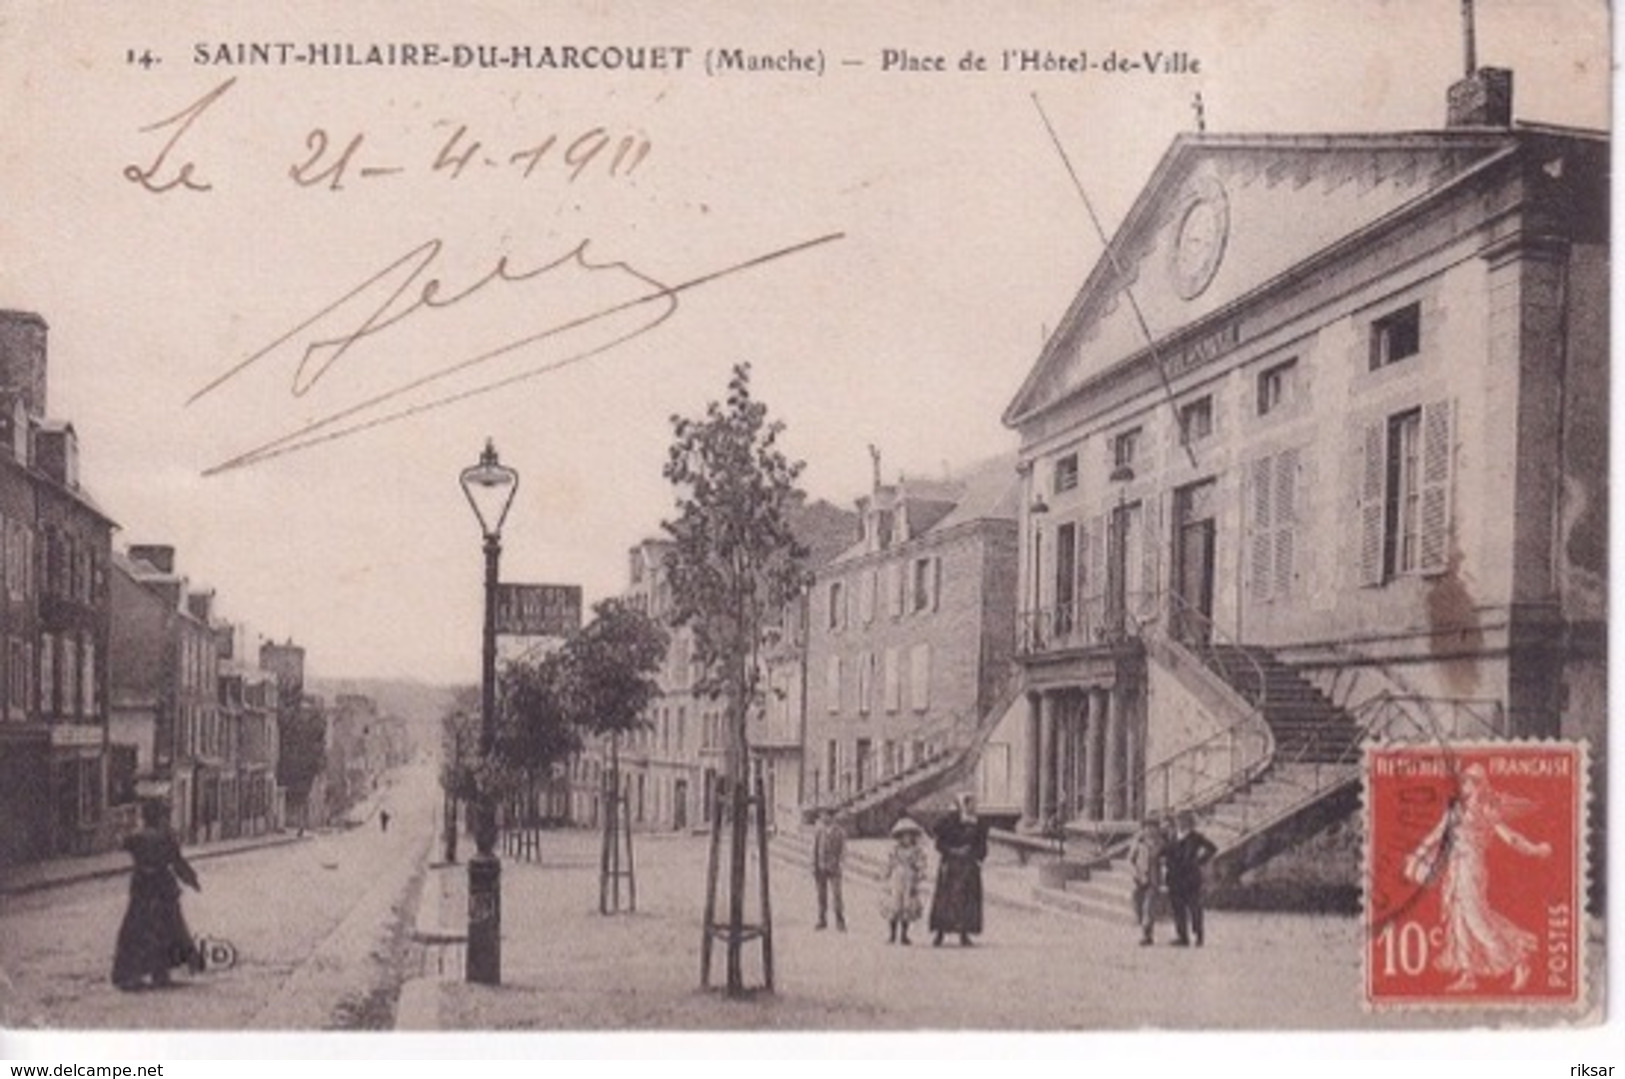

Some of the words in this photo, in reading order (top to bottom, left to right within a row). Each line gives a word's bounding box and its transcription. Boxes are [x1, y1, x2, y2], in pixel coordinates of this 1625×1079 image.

[126, 48, 163, 70] 14.
[193, 42, 692, 71] SAINT-HILAIRE-DU-HARCOUET
[705, 48, 826, 76] (Manche)
[881, 48, 947, 72] Place
[957, 49, 987, 72] de
[1002, 48, 1201, 74] l'Hôtel-de-Ville
[1547, 903, 1569, 989] POSTES
